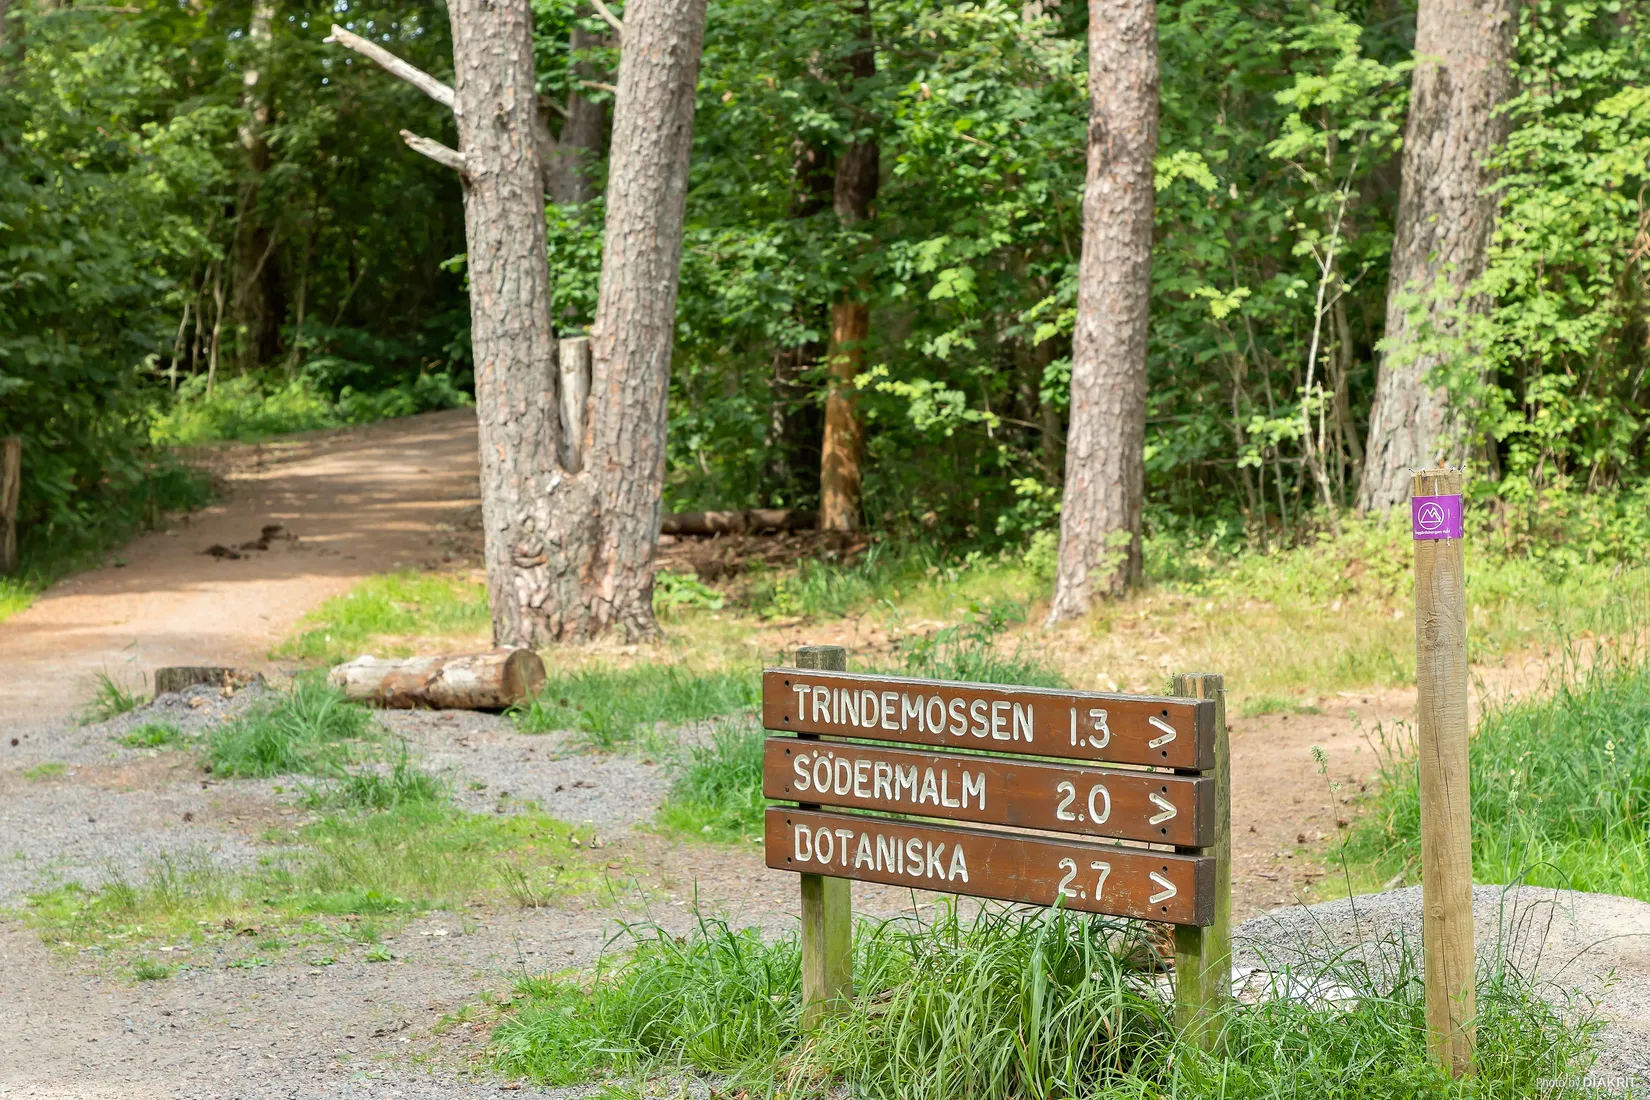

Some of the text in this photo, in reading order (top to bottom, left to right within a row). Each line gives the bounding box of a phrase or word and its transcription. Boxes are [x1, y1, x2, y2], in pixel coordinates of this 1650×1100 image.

[792, 683, 1111, 749] TRINDEMOSSEN 1.3
[793, 749, 1111, 824] SÖDERMALM 2.0
[794, 823, 1111, 900] BOTANISKA 2.7
